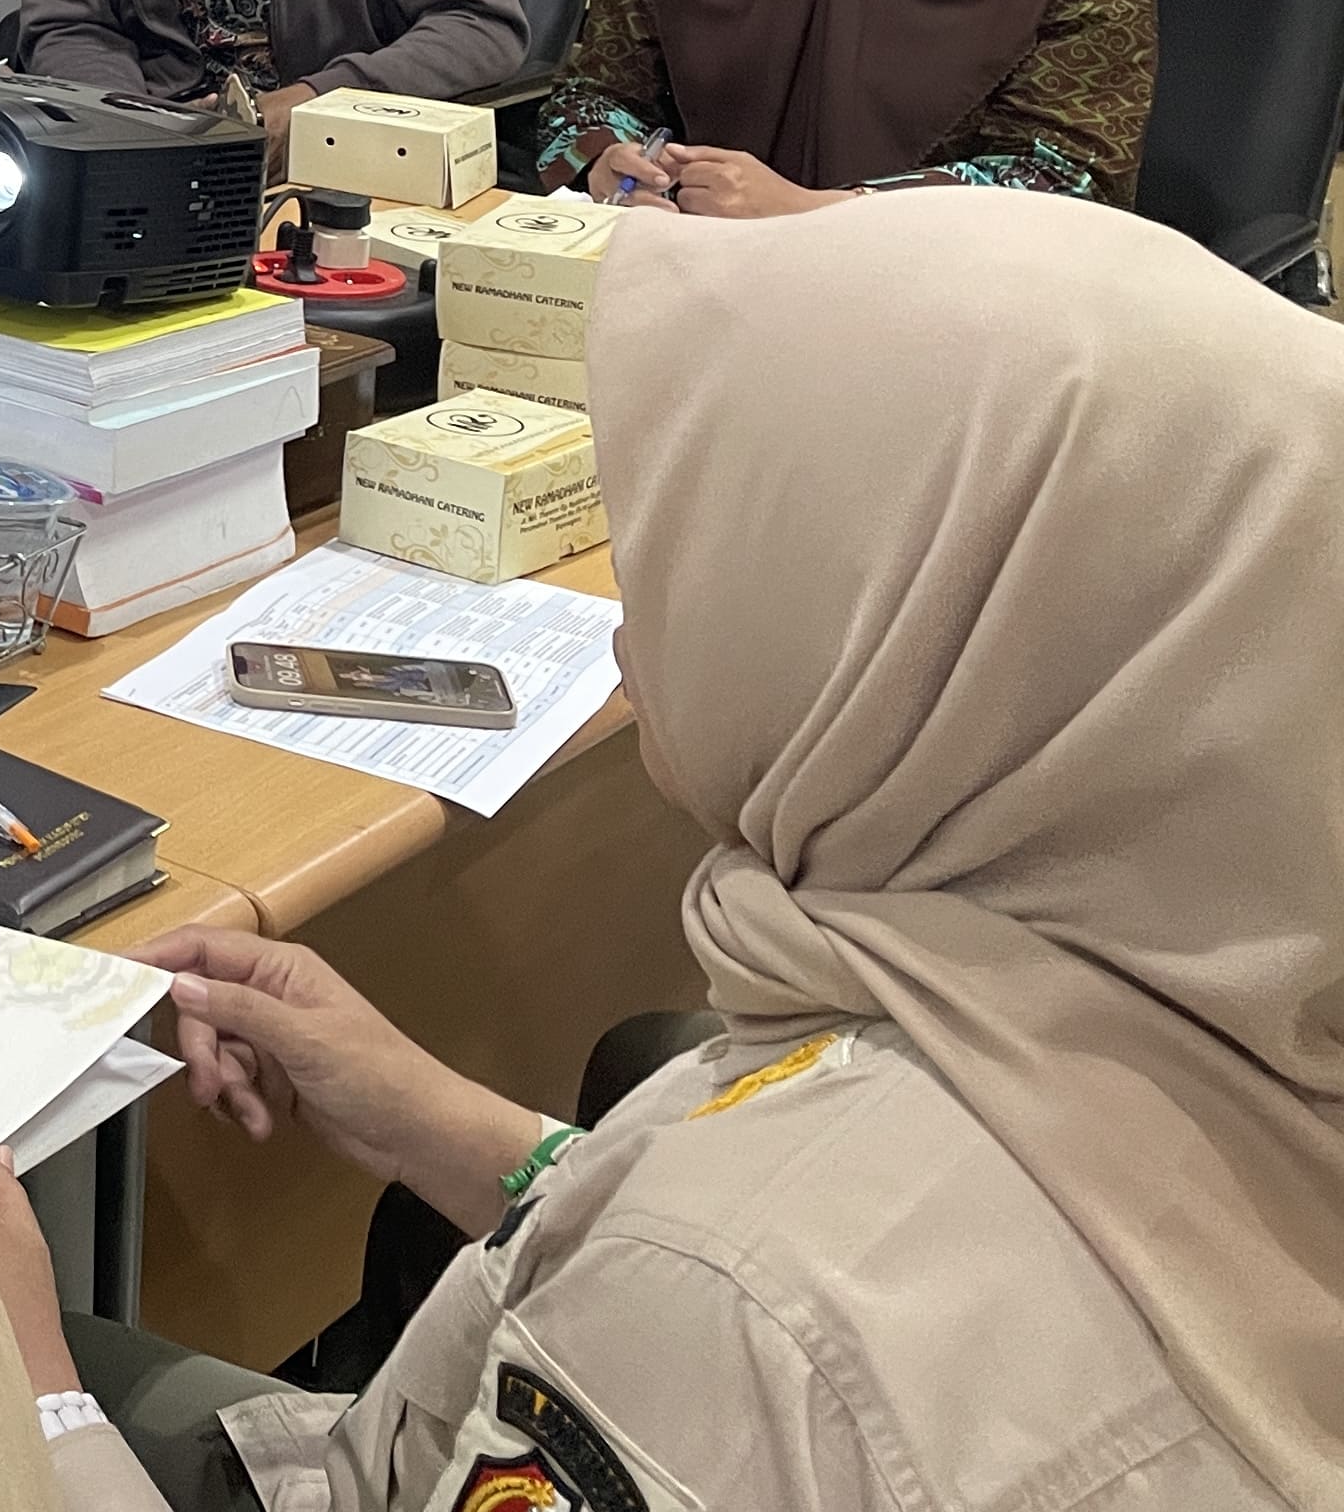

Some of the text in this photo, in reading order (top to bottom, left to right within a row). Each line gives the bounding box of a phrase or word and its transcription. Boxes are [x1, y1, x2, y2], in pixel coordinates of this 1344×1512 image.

[451, 281, 584, 311] NEW RAMADHANI CATERING
[537, 395, 586, 411] CATERING
[355, 477, 485, 522] NEW RAMADHANI CATERING
[512, 497, 533, 516] NEW
[535, 478, 585, 510] RAMADHANI
[273, 653, 303, 686] 09.48
